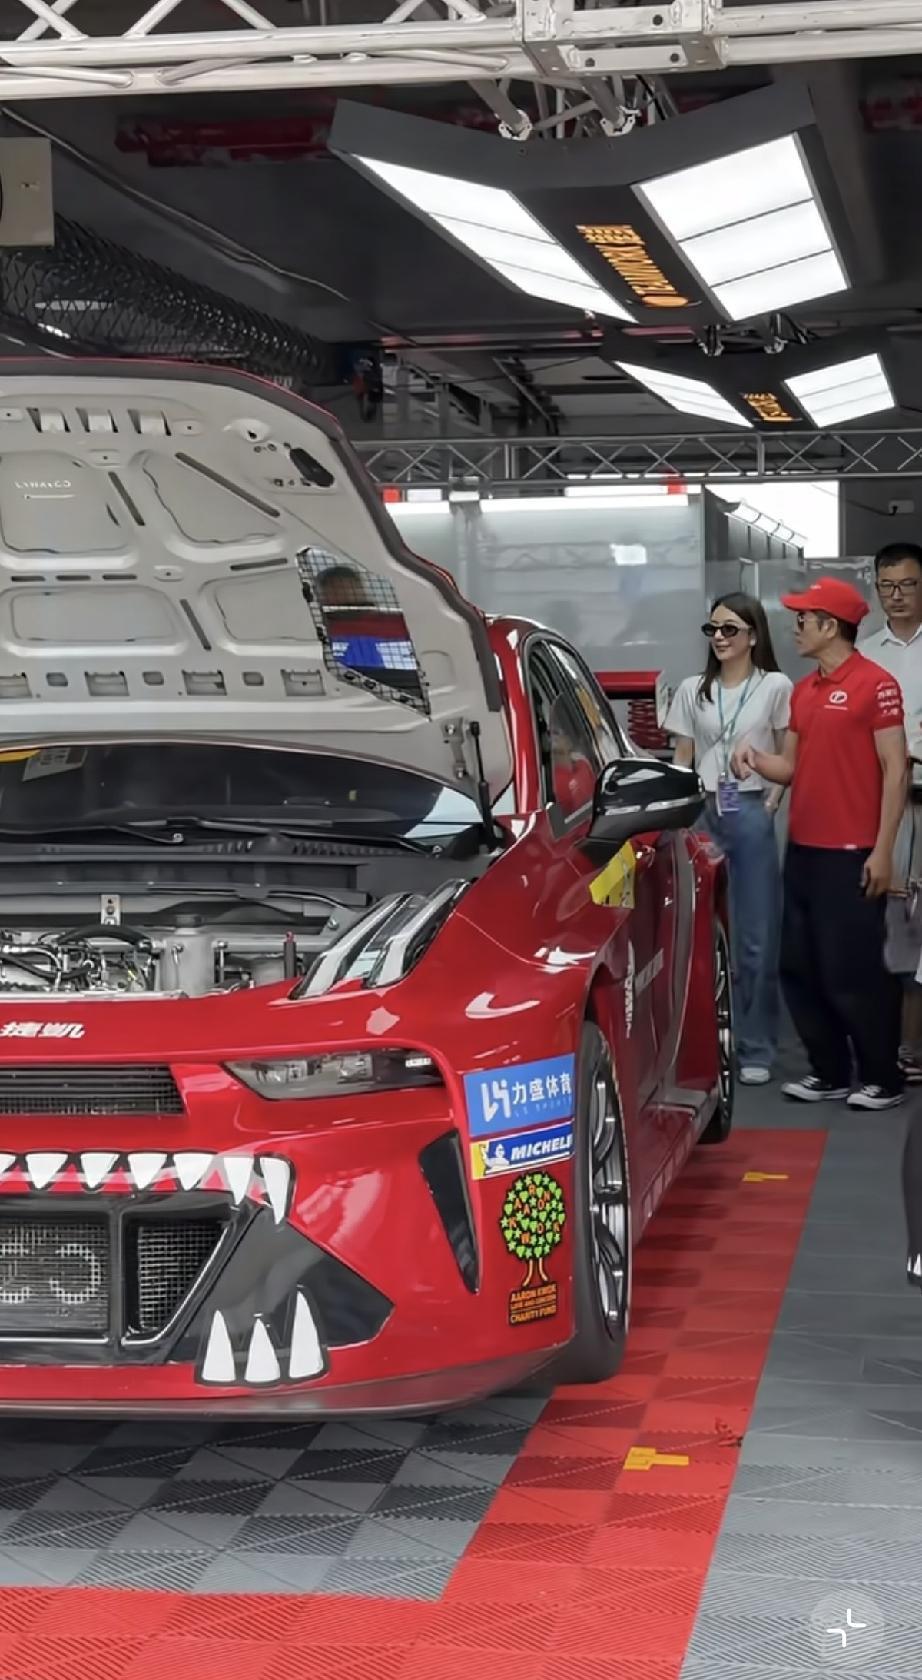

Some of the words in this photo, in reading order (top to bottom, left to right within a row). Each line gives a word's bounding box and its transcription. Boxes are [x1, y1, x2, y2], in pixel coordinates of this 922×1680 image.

[512, 1072, 572, 1104] 力盛体育
[511, 1134, 573, 1161] MICHELI
